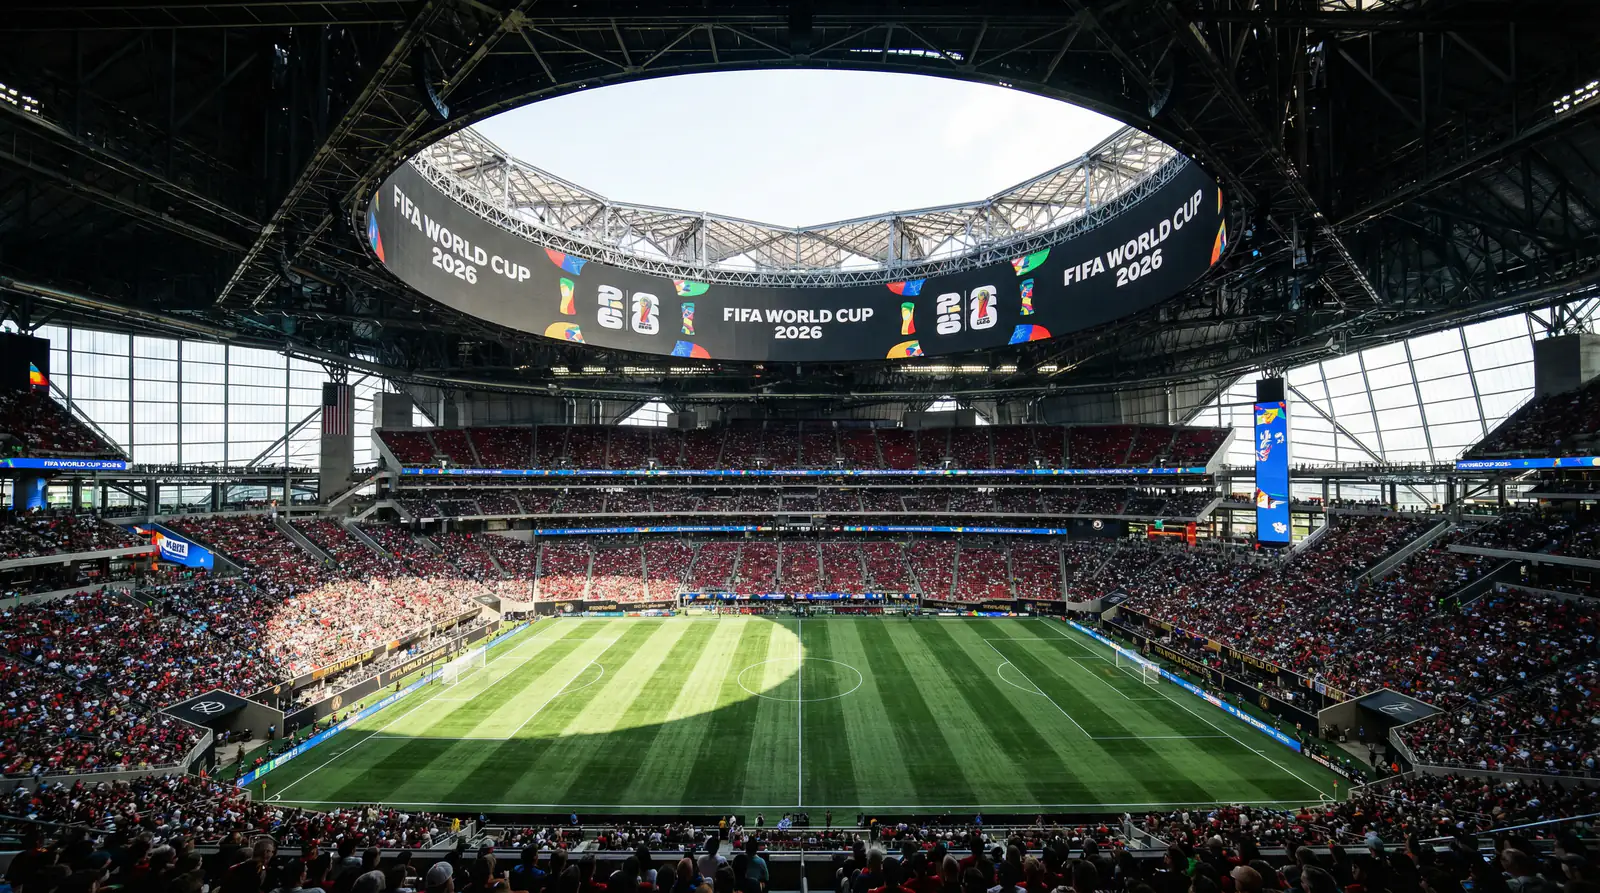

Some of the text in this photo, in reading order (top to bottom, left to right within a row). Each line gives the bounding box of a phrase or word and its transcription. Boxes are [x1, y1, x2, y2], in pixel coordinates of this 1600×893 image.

[394, 184, 531, 282] FIFA WORLD CUP
[1064, 189, 1202, 286] FIFA WORLD CUP
[432, 246, 477, 284] 2026
[1116, 248, 1162, 287] 2026
[723, 307, 874, 323] FIFA WORLD CUP
[774, 325, 823, 339] 2026
